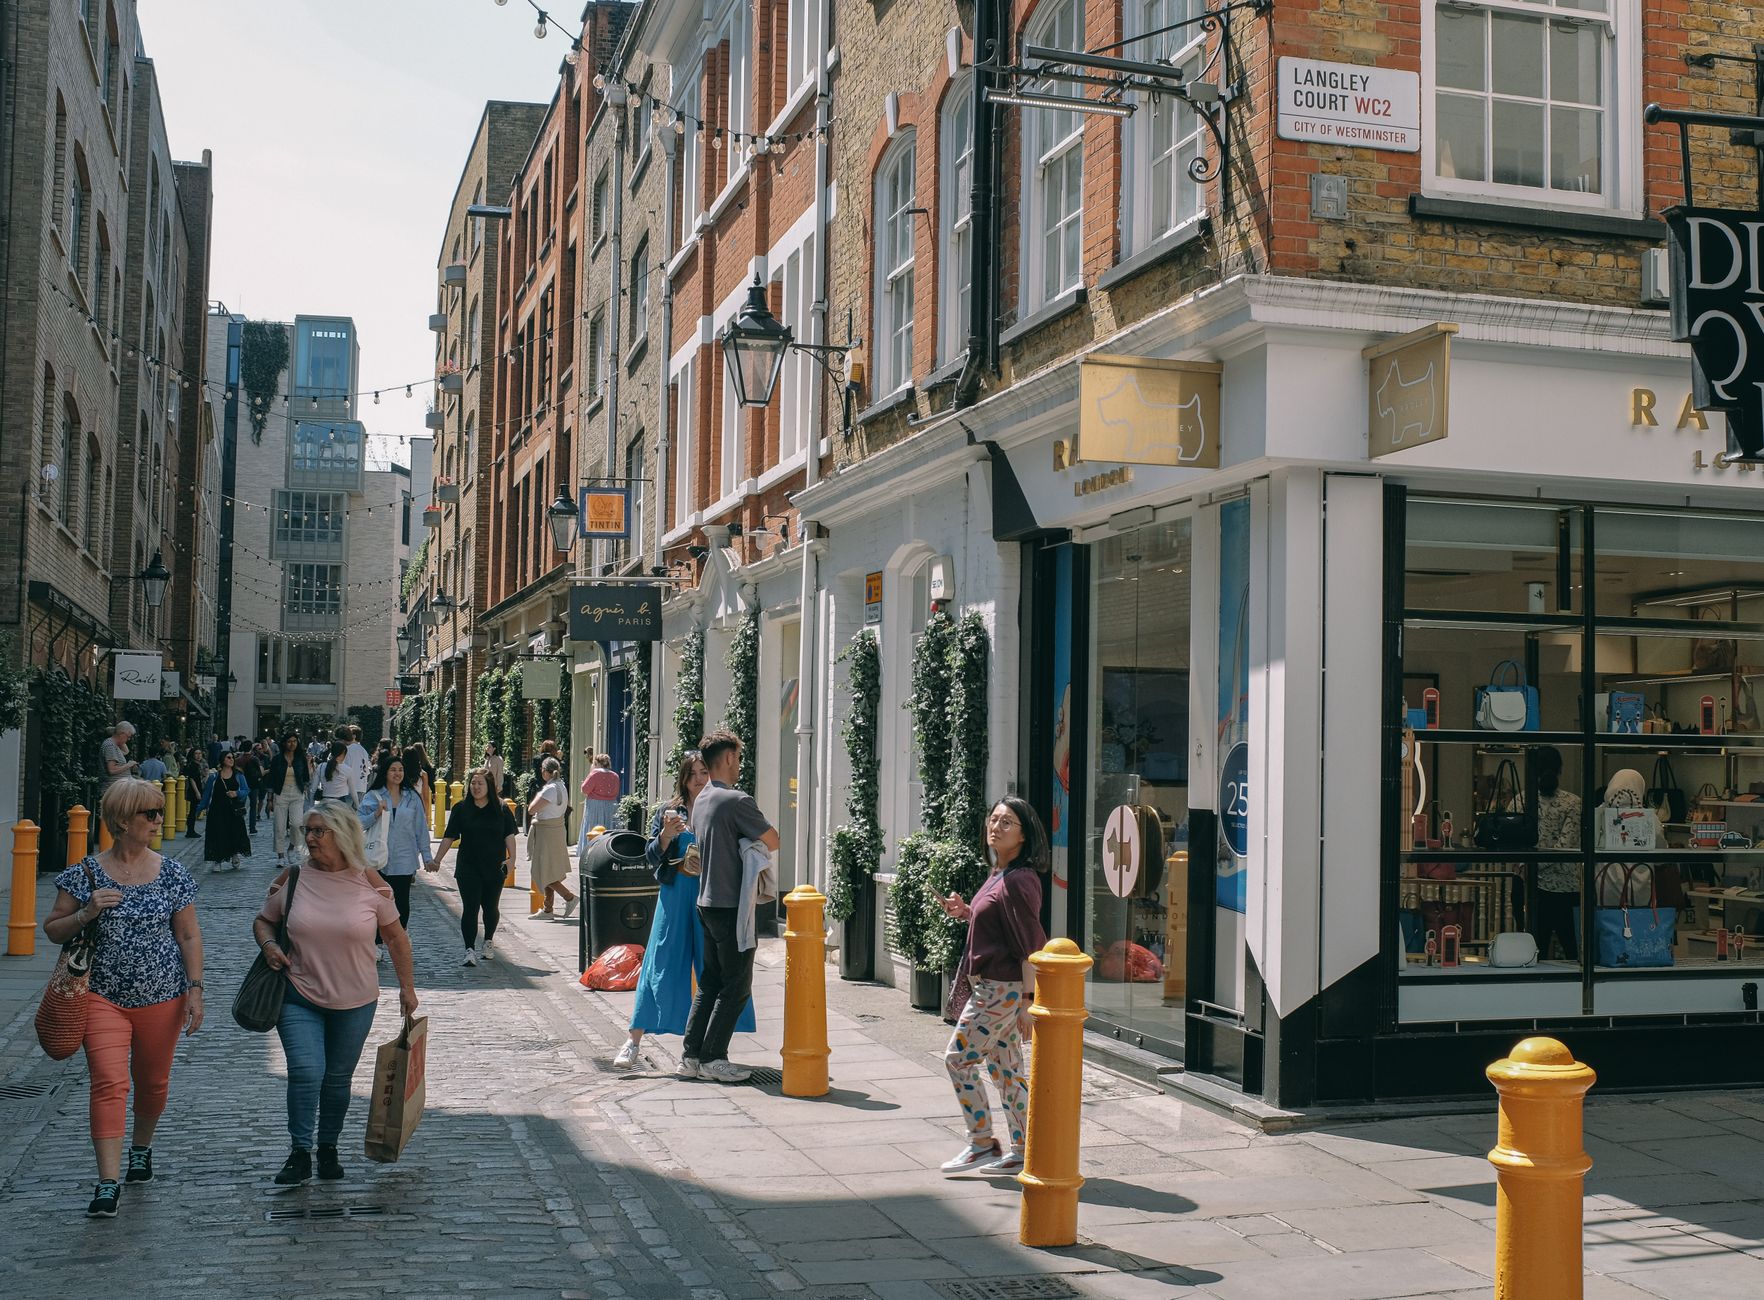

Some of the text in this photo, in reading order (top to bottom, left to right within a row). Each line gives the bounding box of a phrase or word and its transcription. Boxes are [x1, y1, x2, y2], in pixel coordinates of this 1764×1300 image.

[1294, 67, 1370, 92] LANGLEY
[1293, 89, 1392, 117] COURT WC2
[1294, 121, 1406, 143] CITY OF WESTMINSTER
[1074, 464, 1134, 497] LONDON
[590, 520, 621, 529] TINTIN
[580, 603, 624, 623] agnès
[618, 617, 652, 626] PARIS
[119, 669, 157, 686] Rails
